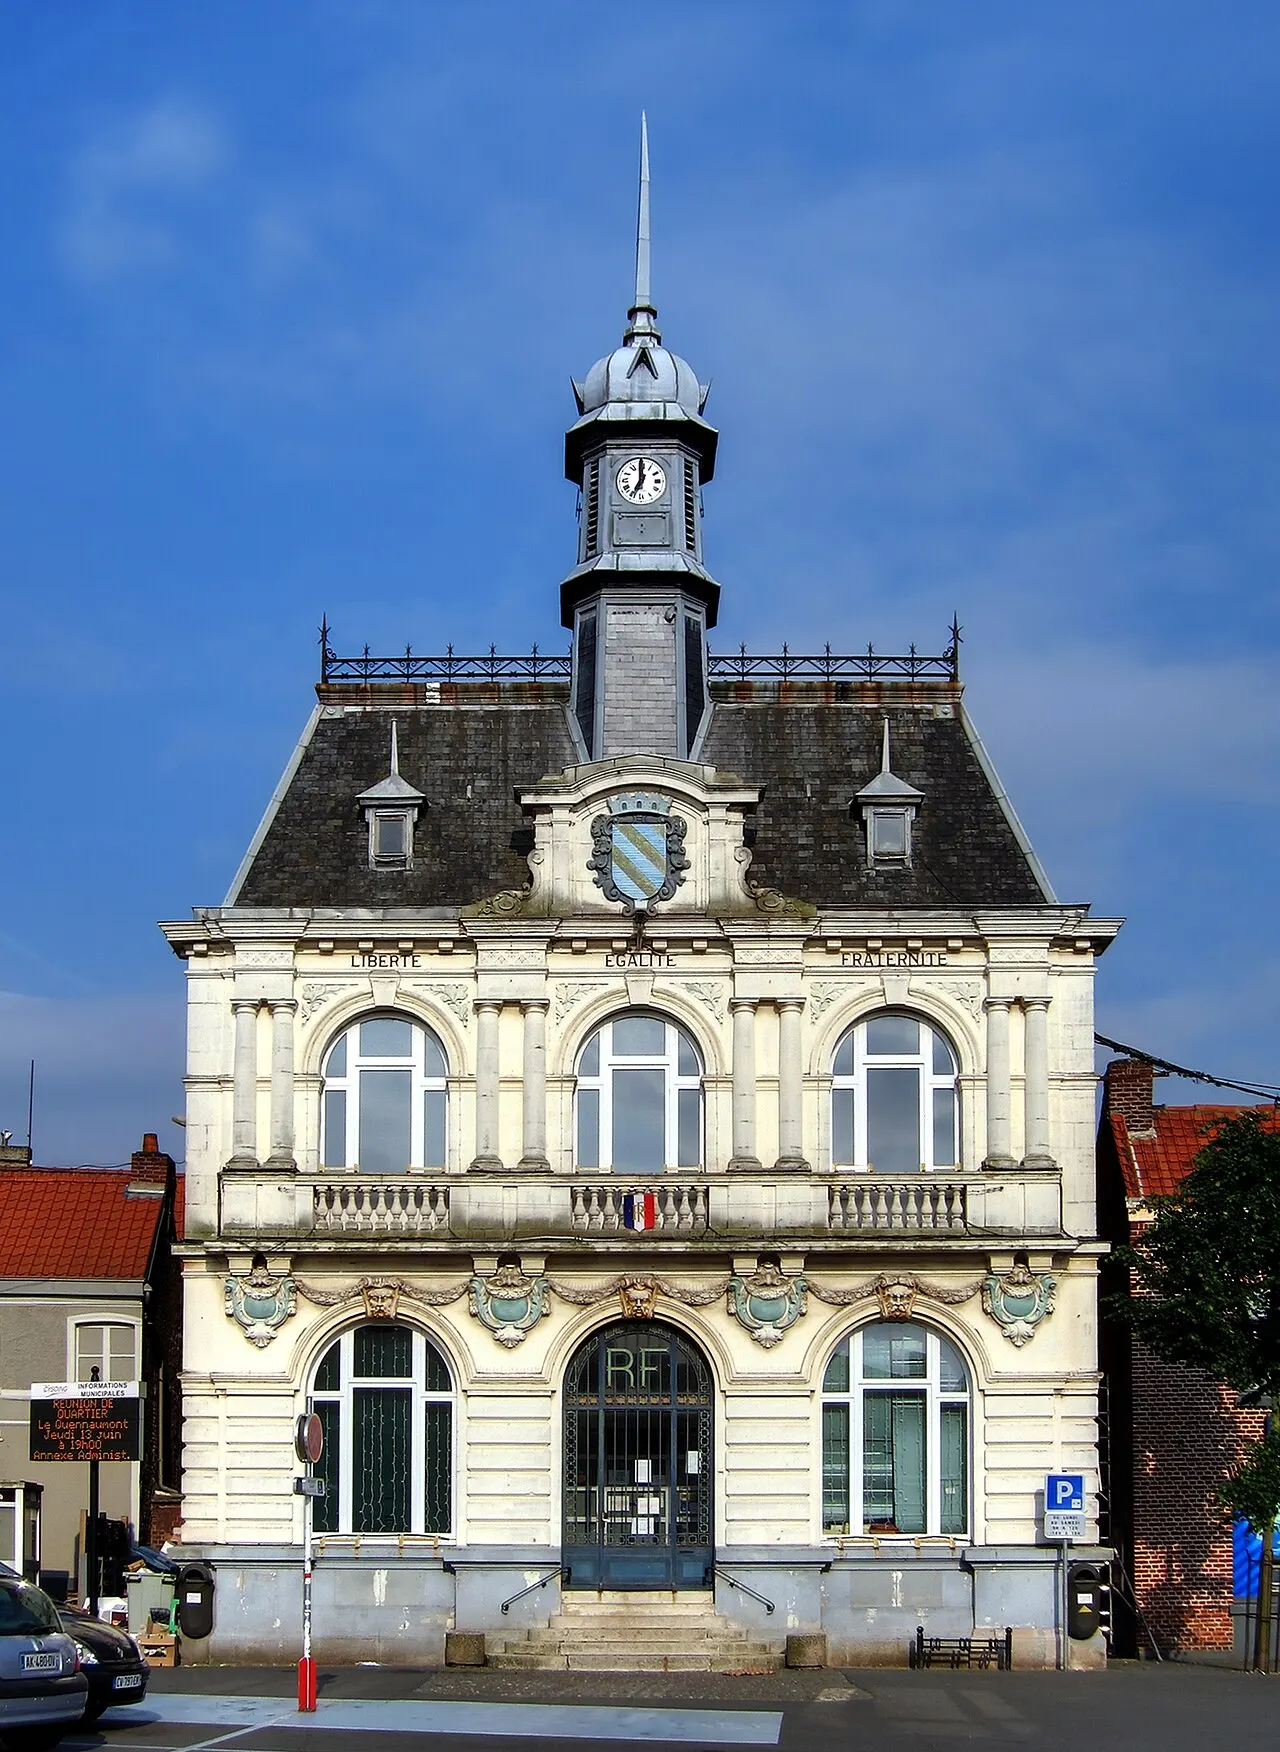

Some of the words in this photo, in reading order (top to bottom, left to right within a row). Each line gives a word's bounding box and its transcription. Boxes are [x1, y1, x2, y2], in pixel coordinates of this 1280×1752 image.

[351, 954, 422, 968] LIBERTE
[605, 954, 677, 967] EGALITE
[841, 952, 948, 966] FRATERNITE
[606, 1347, 669, 1389] RF
[78, 1382, 128, 1390] INFORMATIONS
[101, 1398, 114, 1408] DE
[57, 1408, 108, 1419] QUARTIER
[38, 1420, 51, 1430] Le
[43, 1430, 74, 1440] Jeudi
[80, 1430, 92, 1440] 13
[96, 1430, 122, 1440] juin
[70, 1440, 102, 1450] 19h00
[33, 1450, 74, 1460] Annexe
[77, 1450, 130, 1460] Administ.
[1056, 1480, 1074, 1504] P
